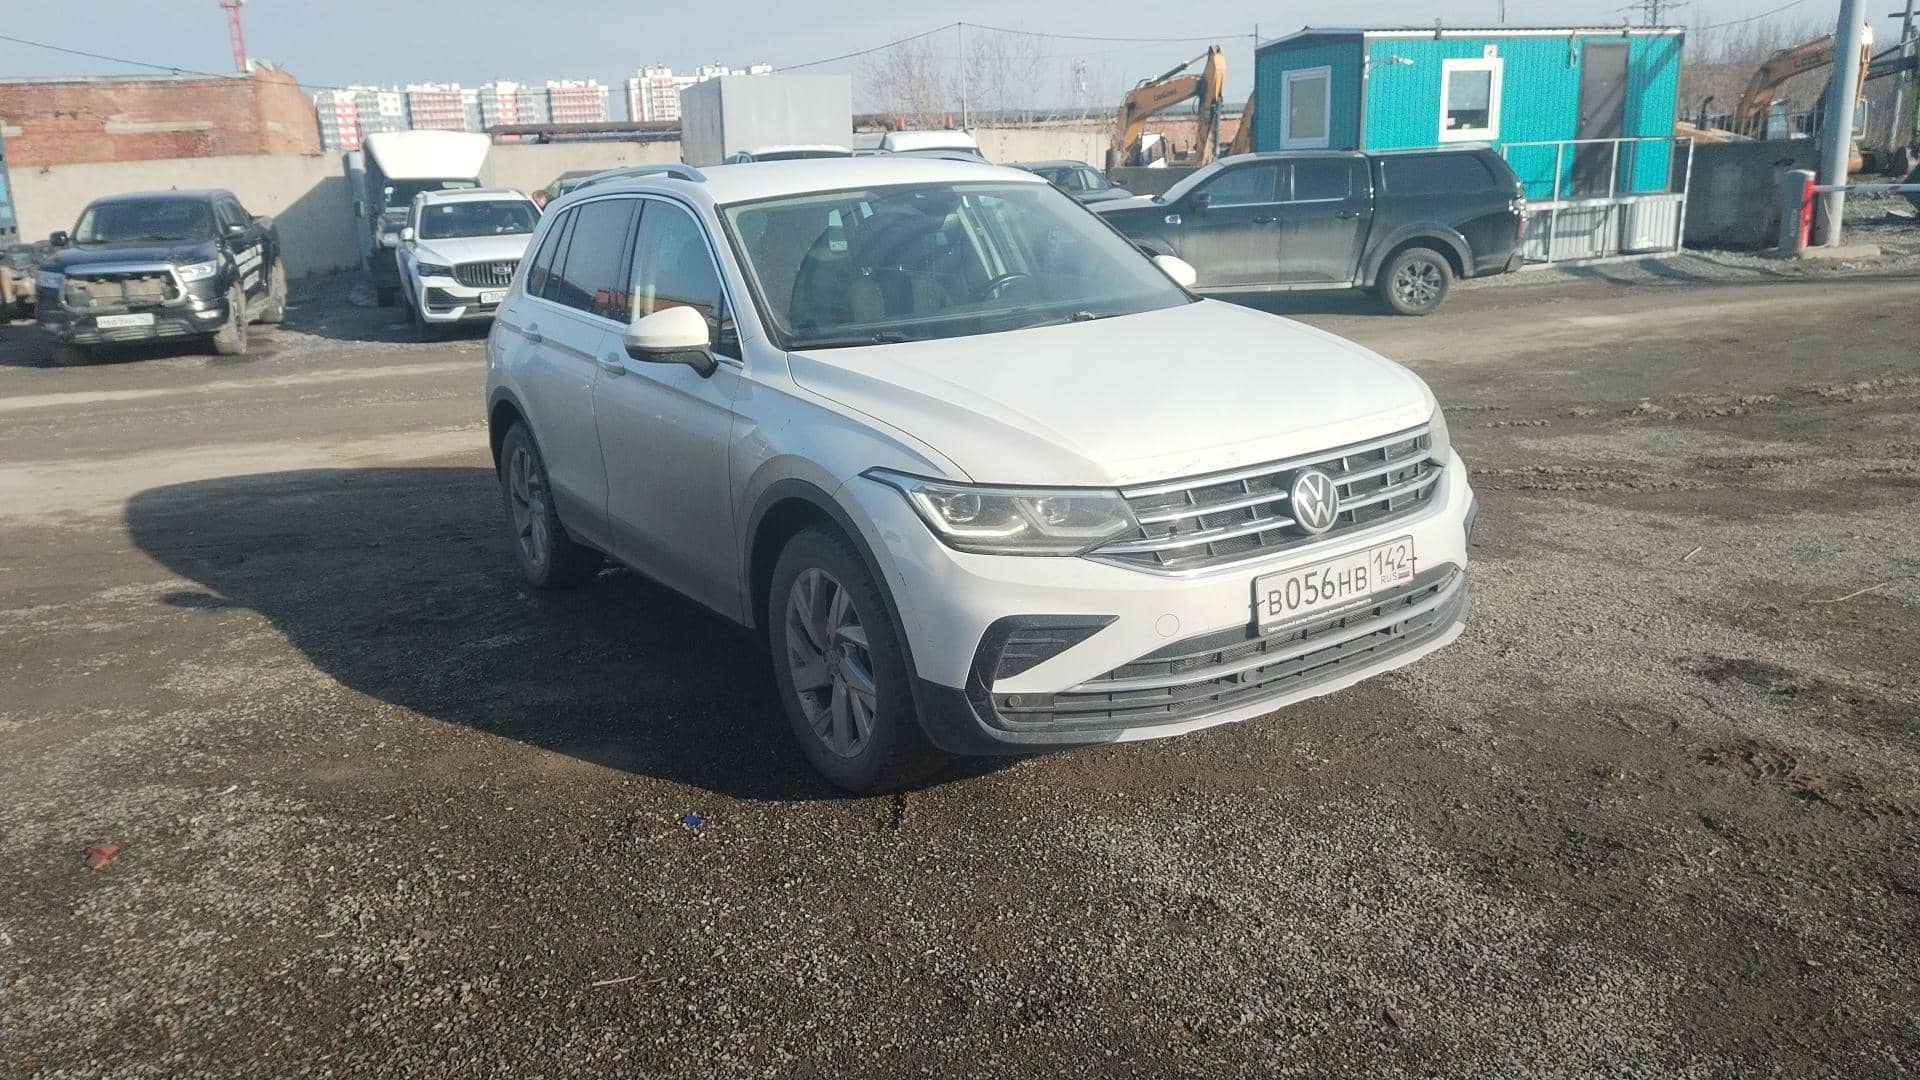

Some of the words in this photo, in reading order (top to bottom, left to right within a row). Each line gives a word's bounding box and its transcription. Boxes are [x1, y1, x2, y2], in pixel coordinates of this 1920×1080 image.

[1268, 565, 1367, 616] В056НВ
[1373, 544, 1406, 575] 142
[1380, 571, 1397, 585] RUS
